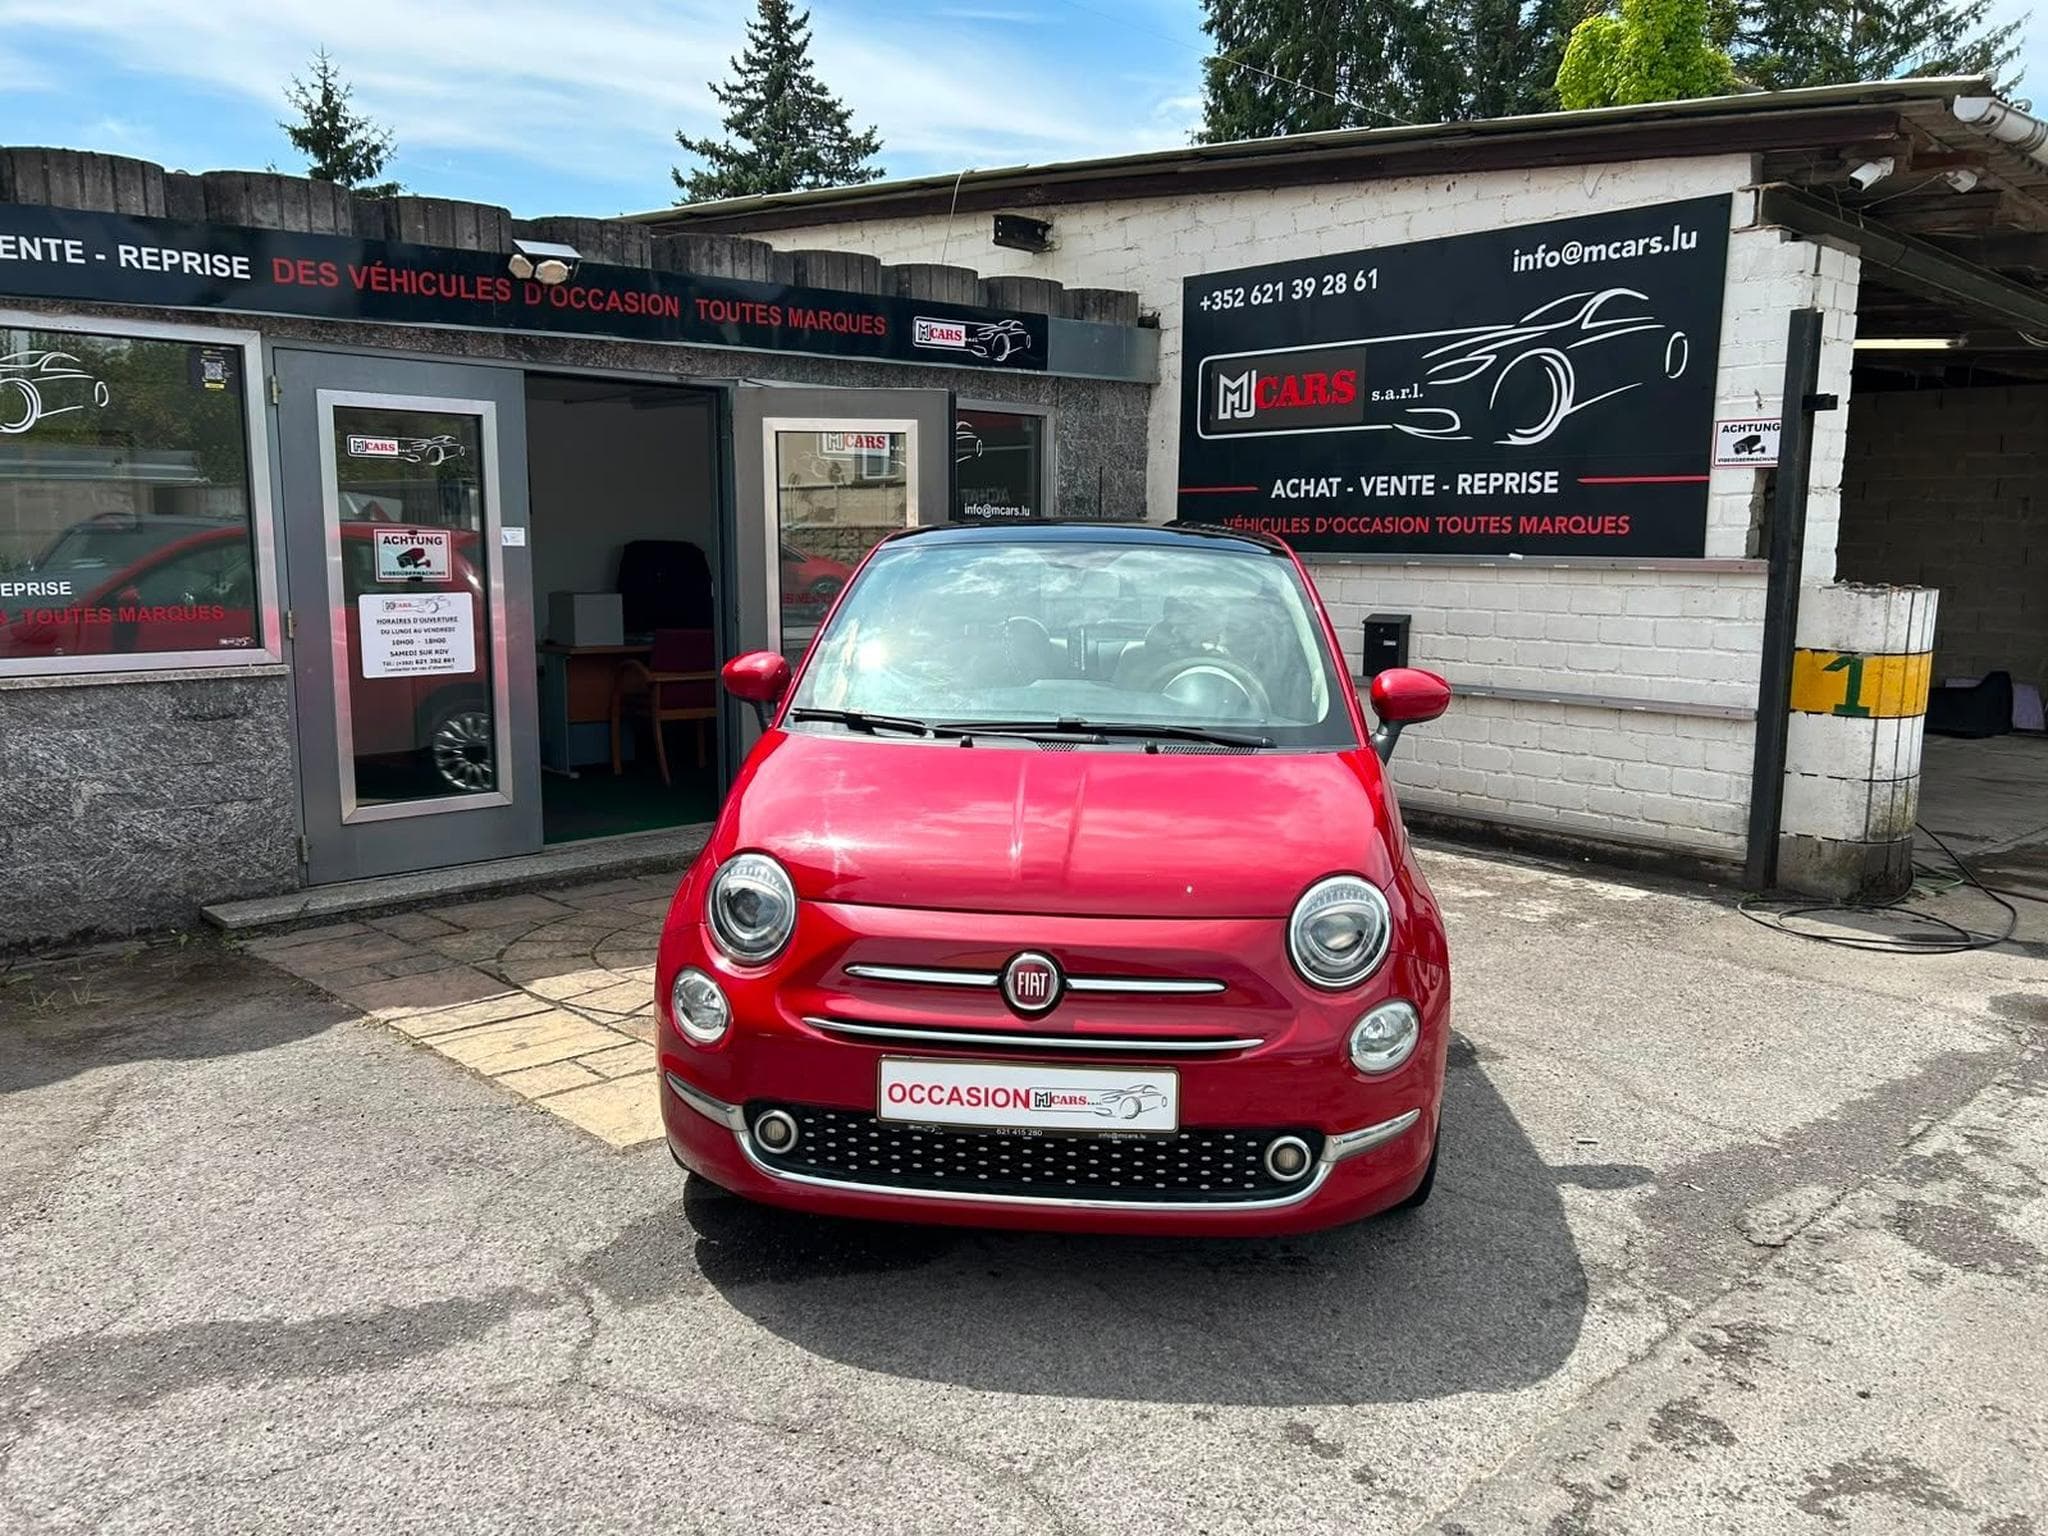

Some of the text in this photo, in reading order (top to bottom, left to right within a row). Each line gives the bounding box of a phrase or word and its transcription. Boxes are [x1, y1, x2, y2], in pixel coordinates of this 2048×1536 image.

[1513, 224, 1698, 273] info@mcars.lu
[118, 244, 251, 280] REPRISE
[272, 257, 339, 288] DES
[347, 260, 512, 301] VÉHICULES
[524, 282, 680, 319] D'OCCASION
[696, 299, 782, 326] TOUTES
[788, 308, 887, 336] MARQUES
[1200, 268, 1379, 311] +352 621 39 28 61
[1371, 384, 1423, 401] s.a.r.l.
[1722, 422, 1780, 433] ACHTUNG
[1270, 477, 1342, 499] ACHAT
[1360, 474, 1436, 497] VENTE
[1457, 471, 1559, 495] REPRISE
[964, 502, 1030, 518] info@mcars.lu
[1224, 514, 1631, 535] VÉHICULES D'OCCASION TOUTES MARQUES
[383, 536, 443, 546] ACHTUNG
[0, 581, 72, 597] EPRISE
[23, 607, 113, 625] TOUTES
[118, 605, 225, 623] MARQUES
[376, 618, 411, 626] HORAIRES
[424, 626, 456, 634] VENDREDI
[1822, 655, 1871, 717] 1
[1017, 971, 1048, 997] FIAT
[887, 1082, 1030, 1109] OCCASION
